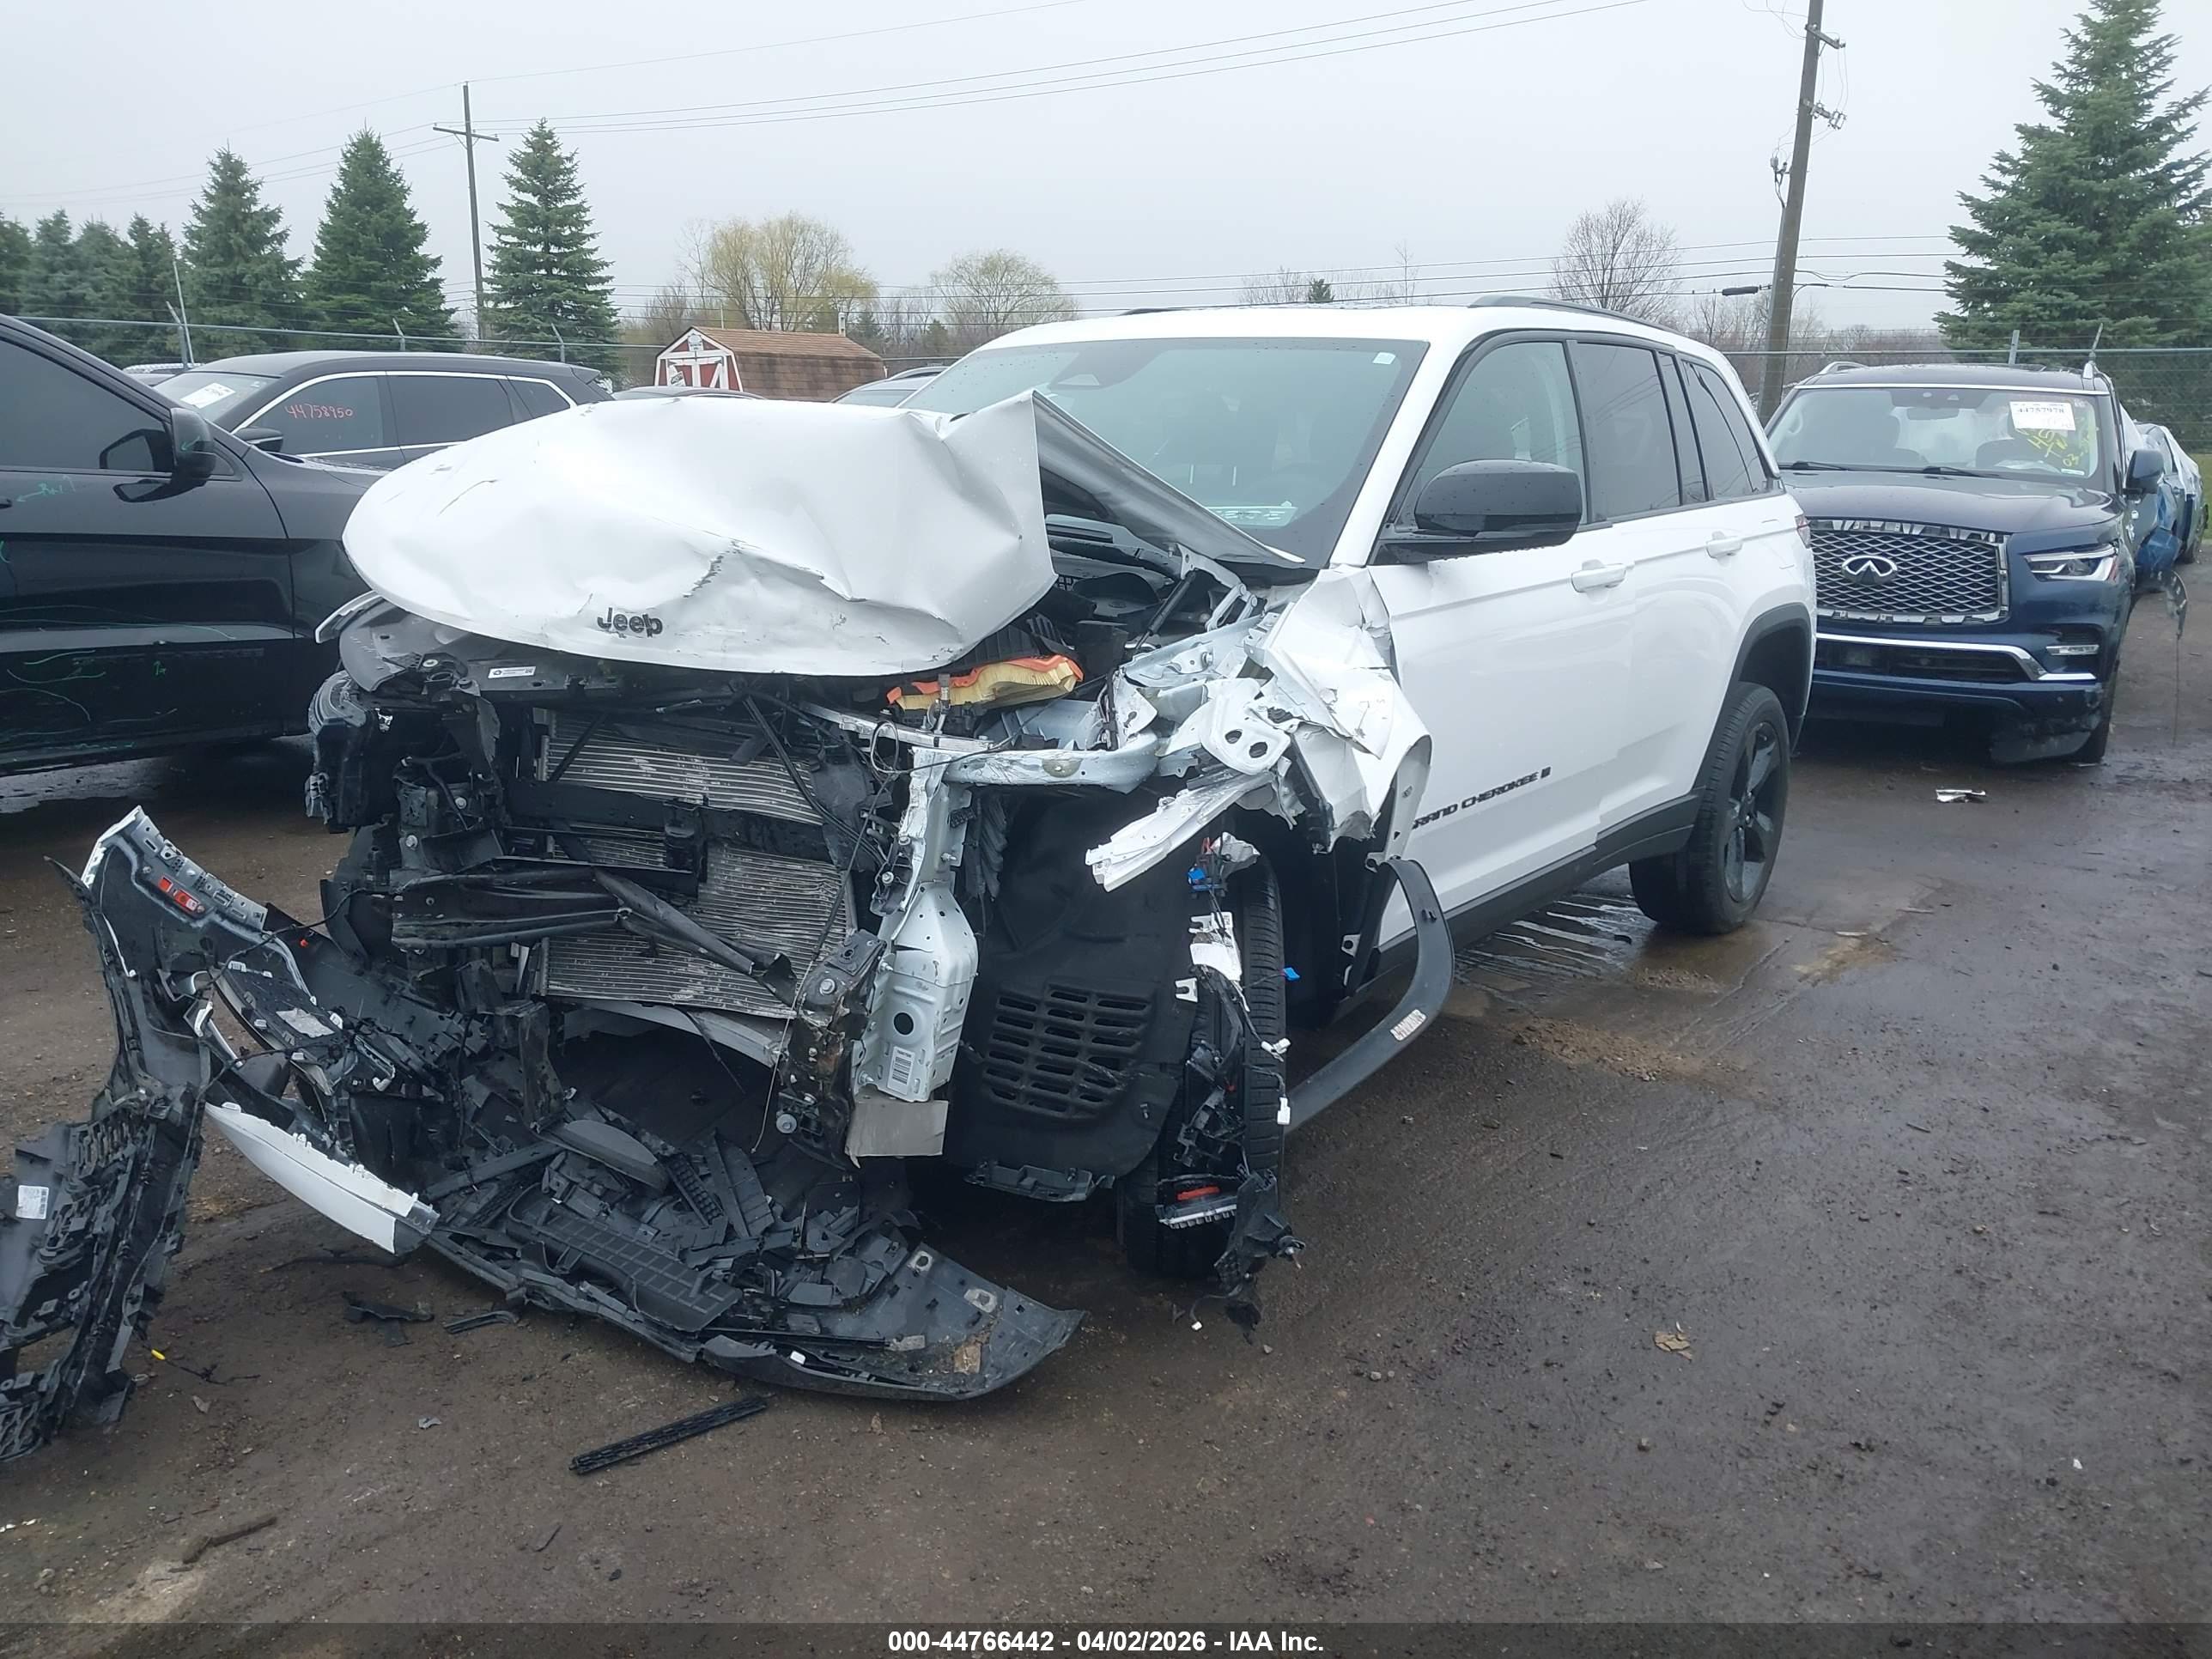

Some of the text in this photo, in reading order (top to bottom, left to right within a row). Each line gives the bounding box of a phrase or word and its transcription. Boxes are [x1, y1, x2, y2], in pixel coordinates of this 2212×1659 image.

[284, 403, 353, 419] 44758950
[597, 607, 663, 638] Jeep
[1412, 771, 1539, 830] RAND CHEROKEE
